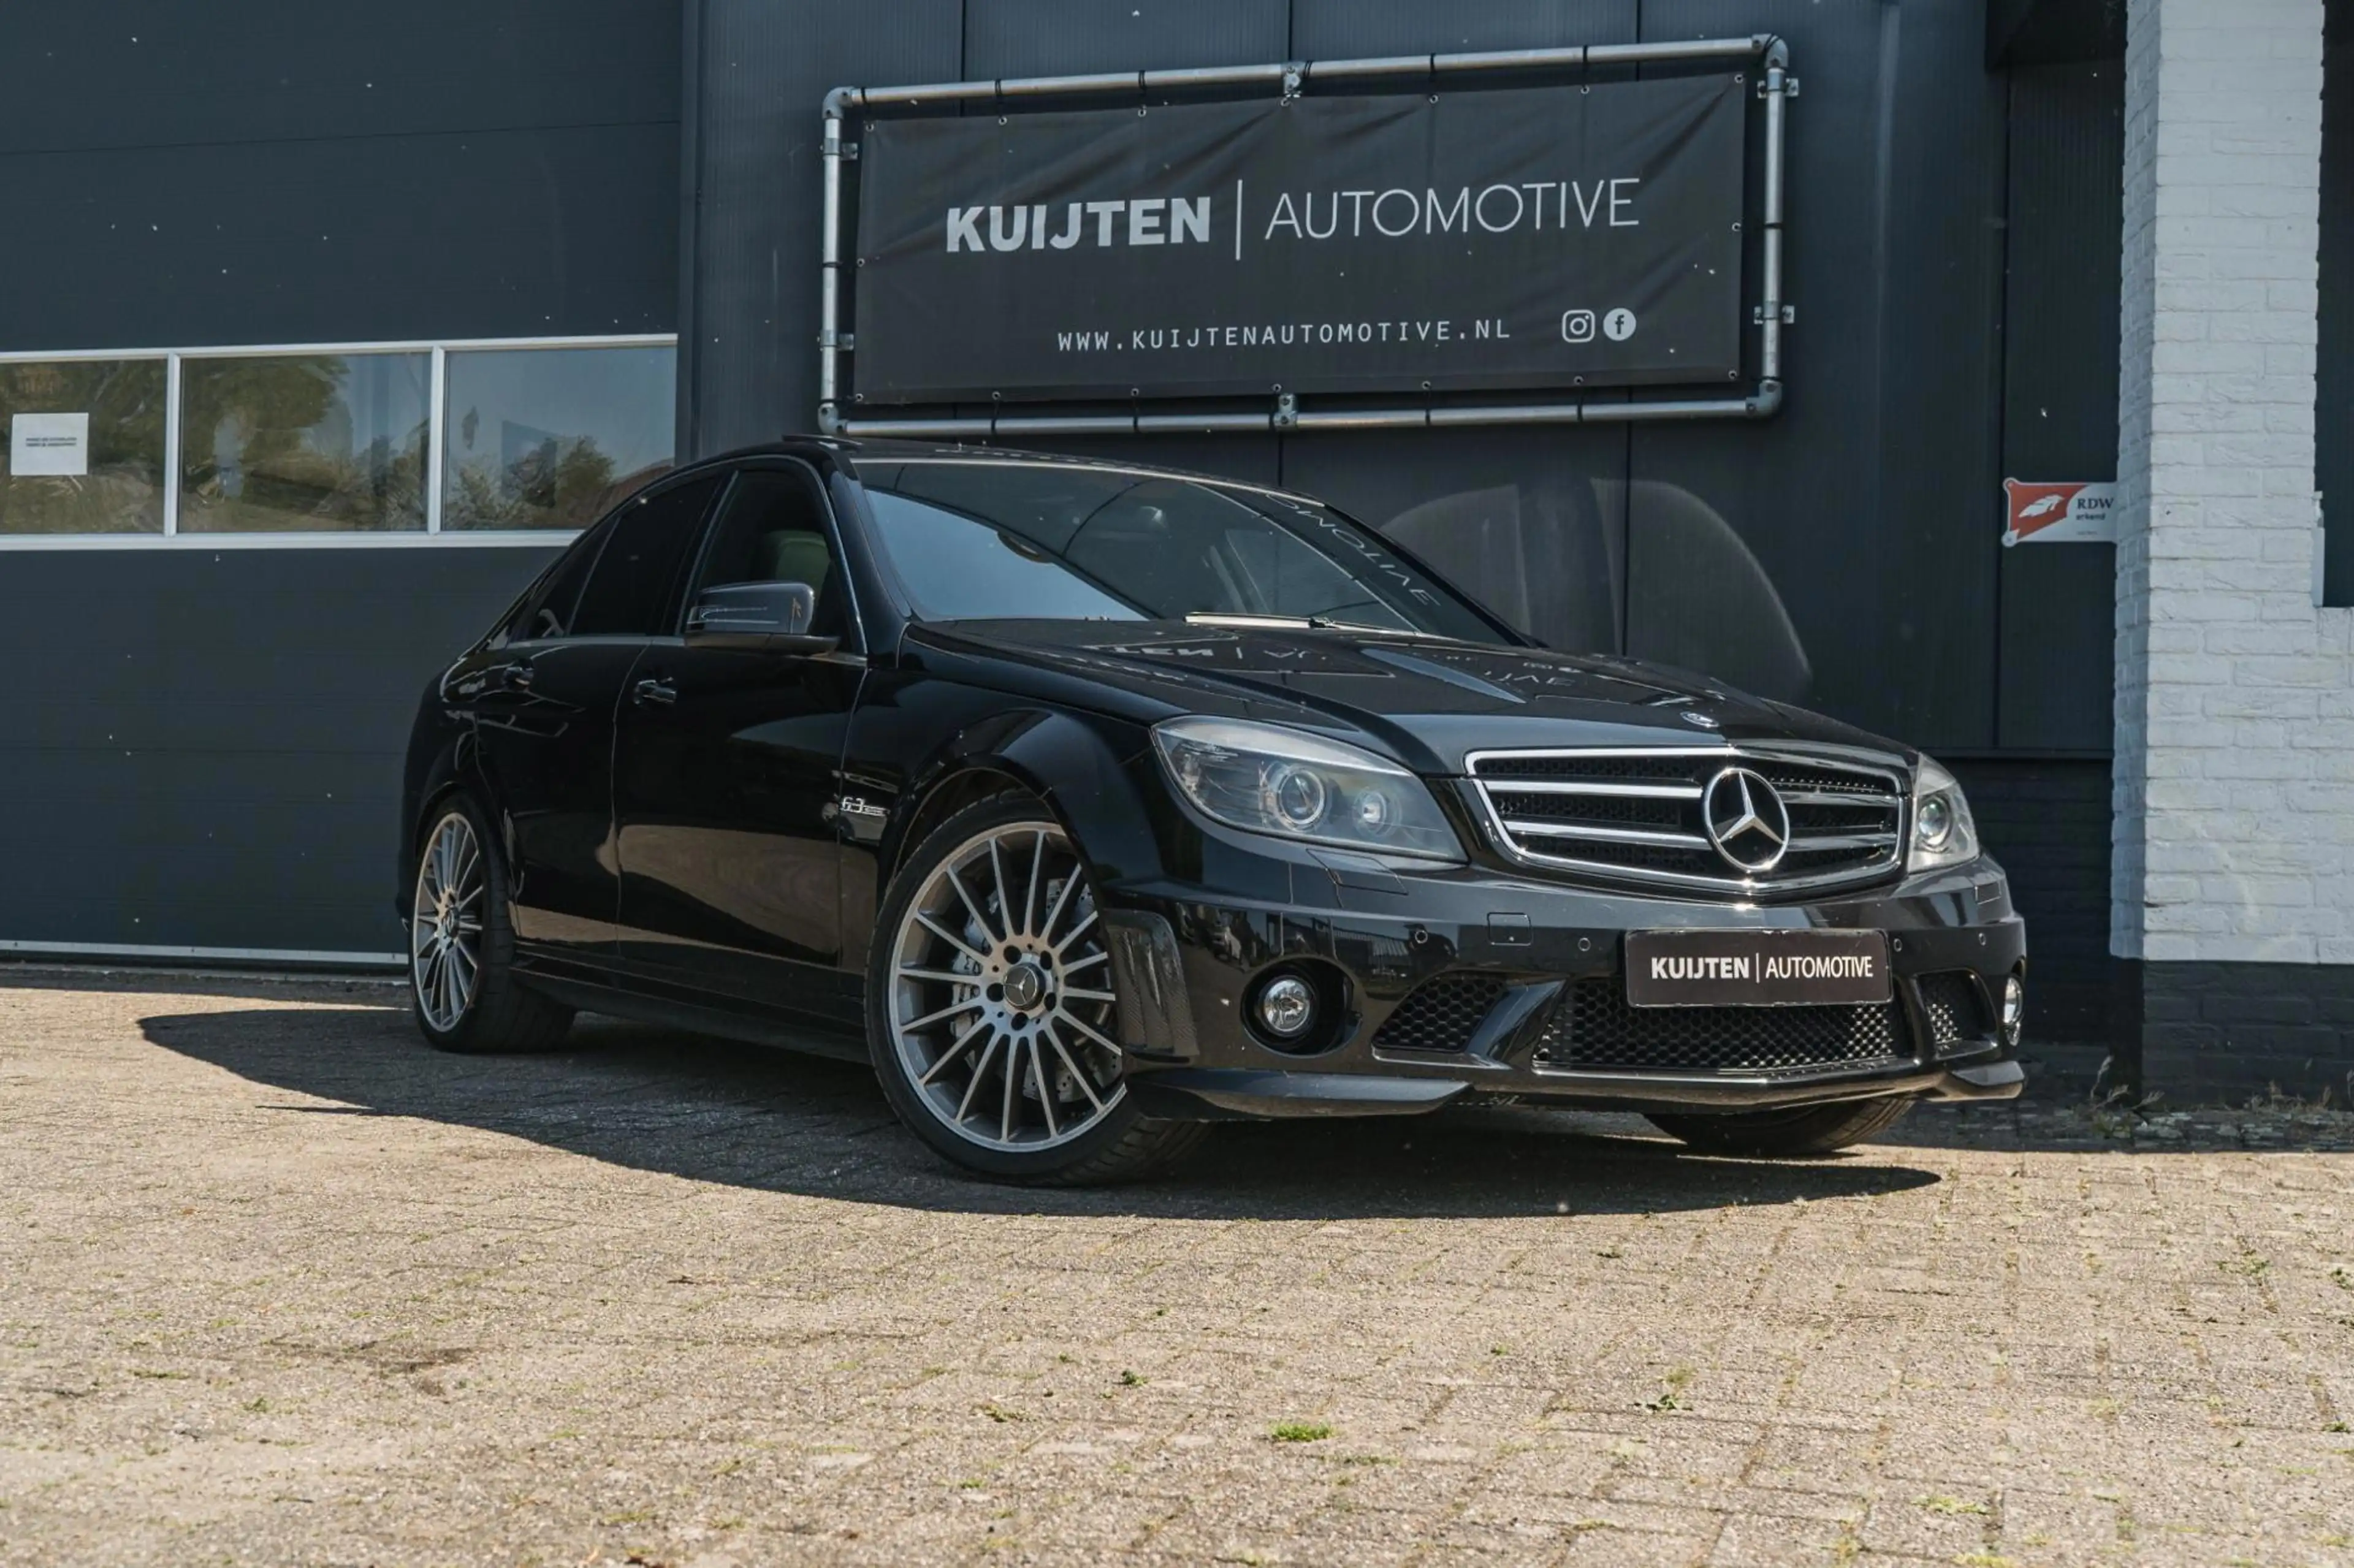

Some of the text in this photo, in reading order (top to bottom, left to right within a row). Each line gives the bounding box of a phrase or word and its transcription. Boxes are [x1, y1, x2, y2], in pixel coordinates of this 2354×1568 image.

[946, 178, 1640, 253] KUIJTEN AUTOMOTIVE
[1057, 319, 1510, 351] WWW.KUIJTENAUTOMOTIVE.NL
[2077, 498, 2114, 509] RDW
[1651, 956, 1873, 980] KUIJTEN AUTOMOTIVE
